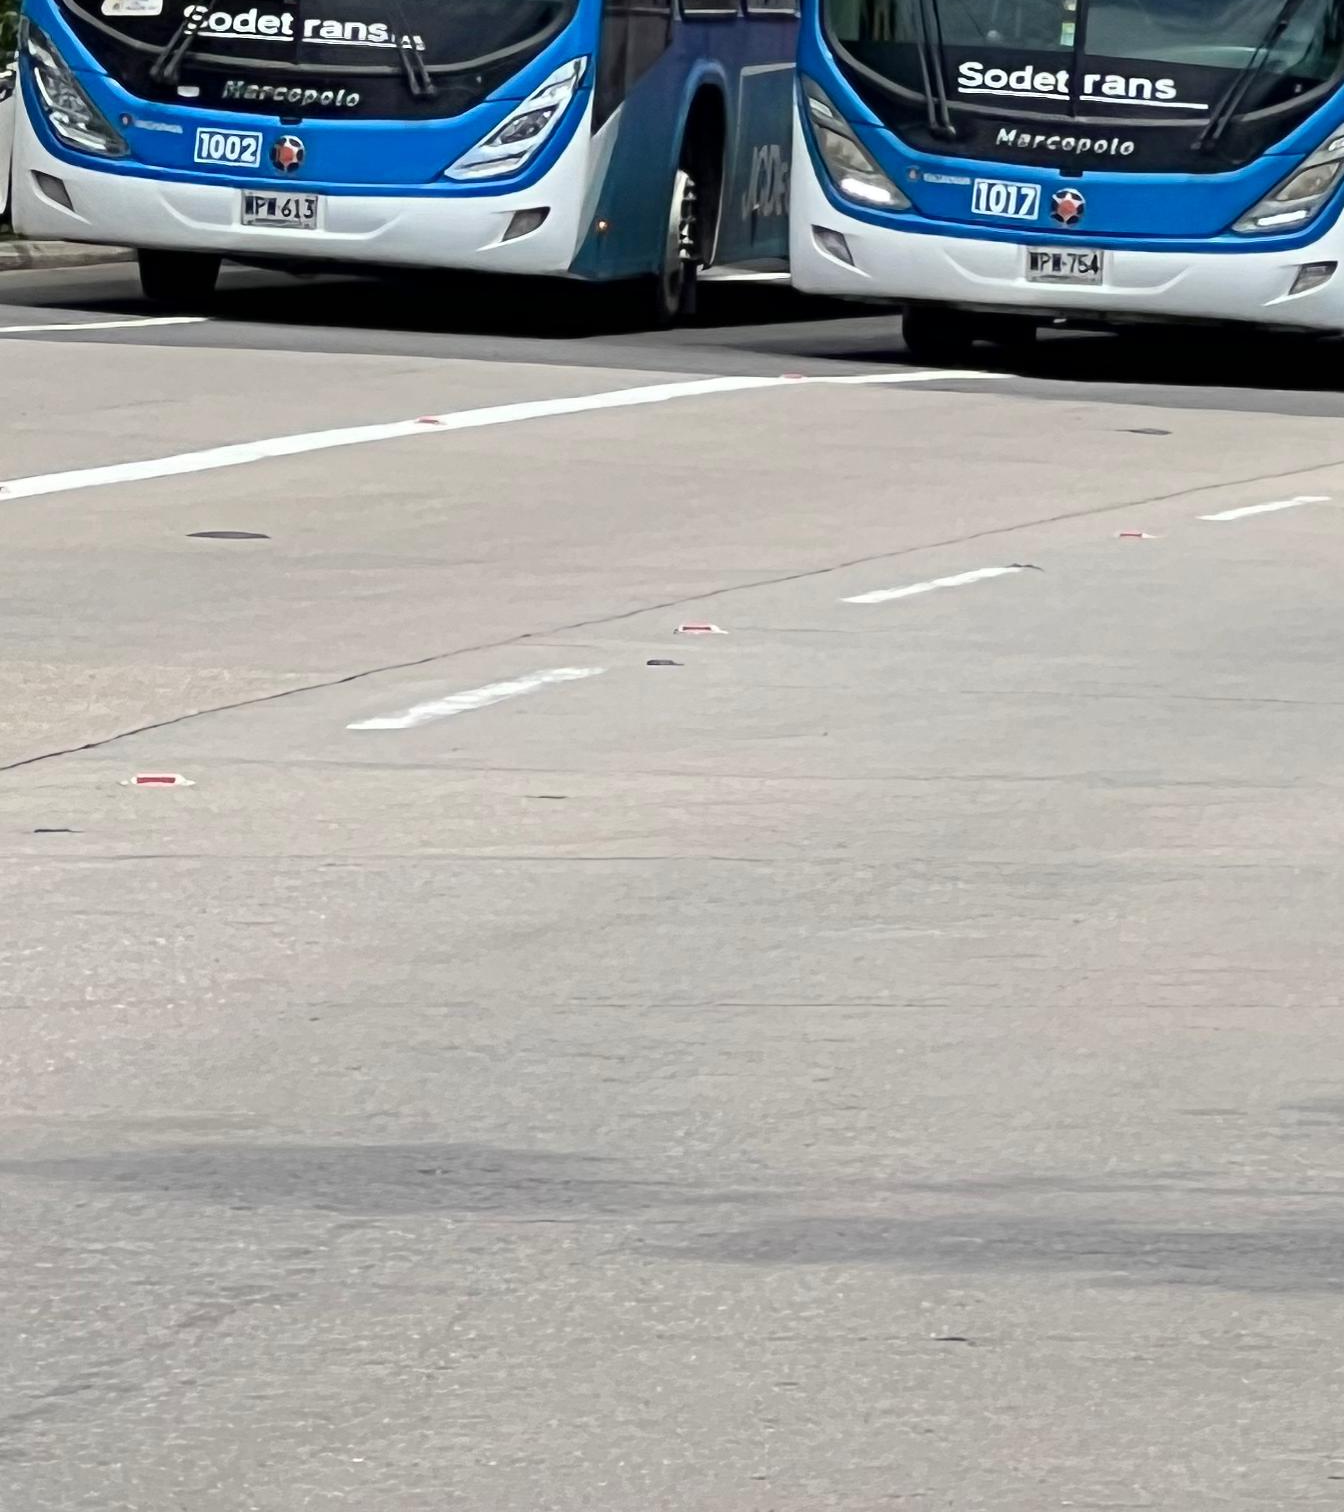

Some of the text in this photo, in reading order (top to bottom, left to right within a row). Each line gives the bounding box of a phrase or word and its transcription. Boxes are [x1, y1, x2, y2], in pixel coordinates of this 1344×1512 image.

[221, 80, 361, 107] Marcopolo
[200, 133, 257, 162] 1002
[996, 127, 1135, 155] Marcopolo
[978, 181, 1036, 216] 1017
